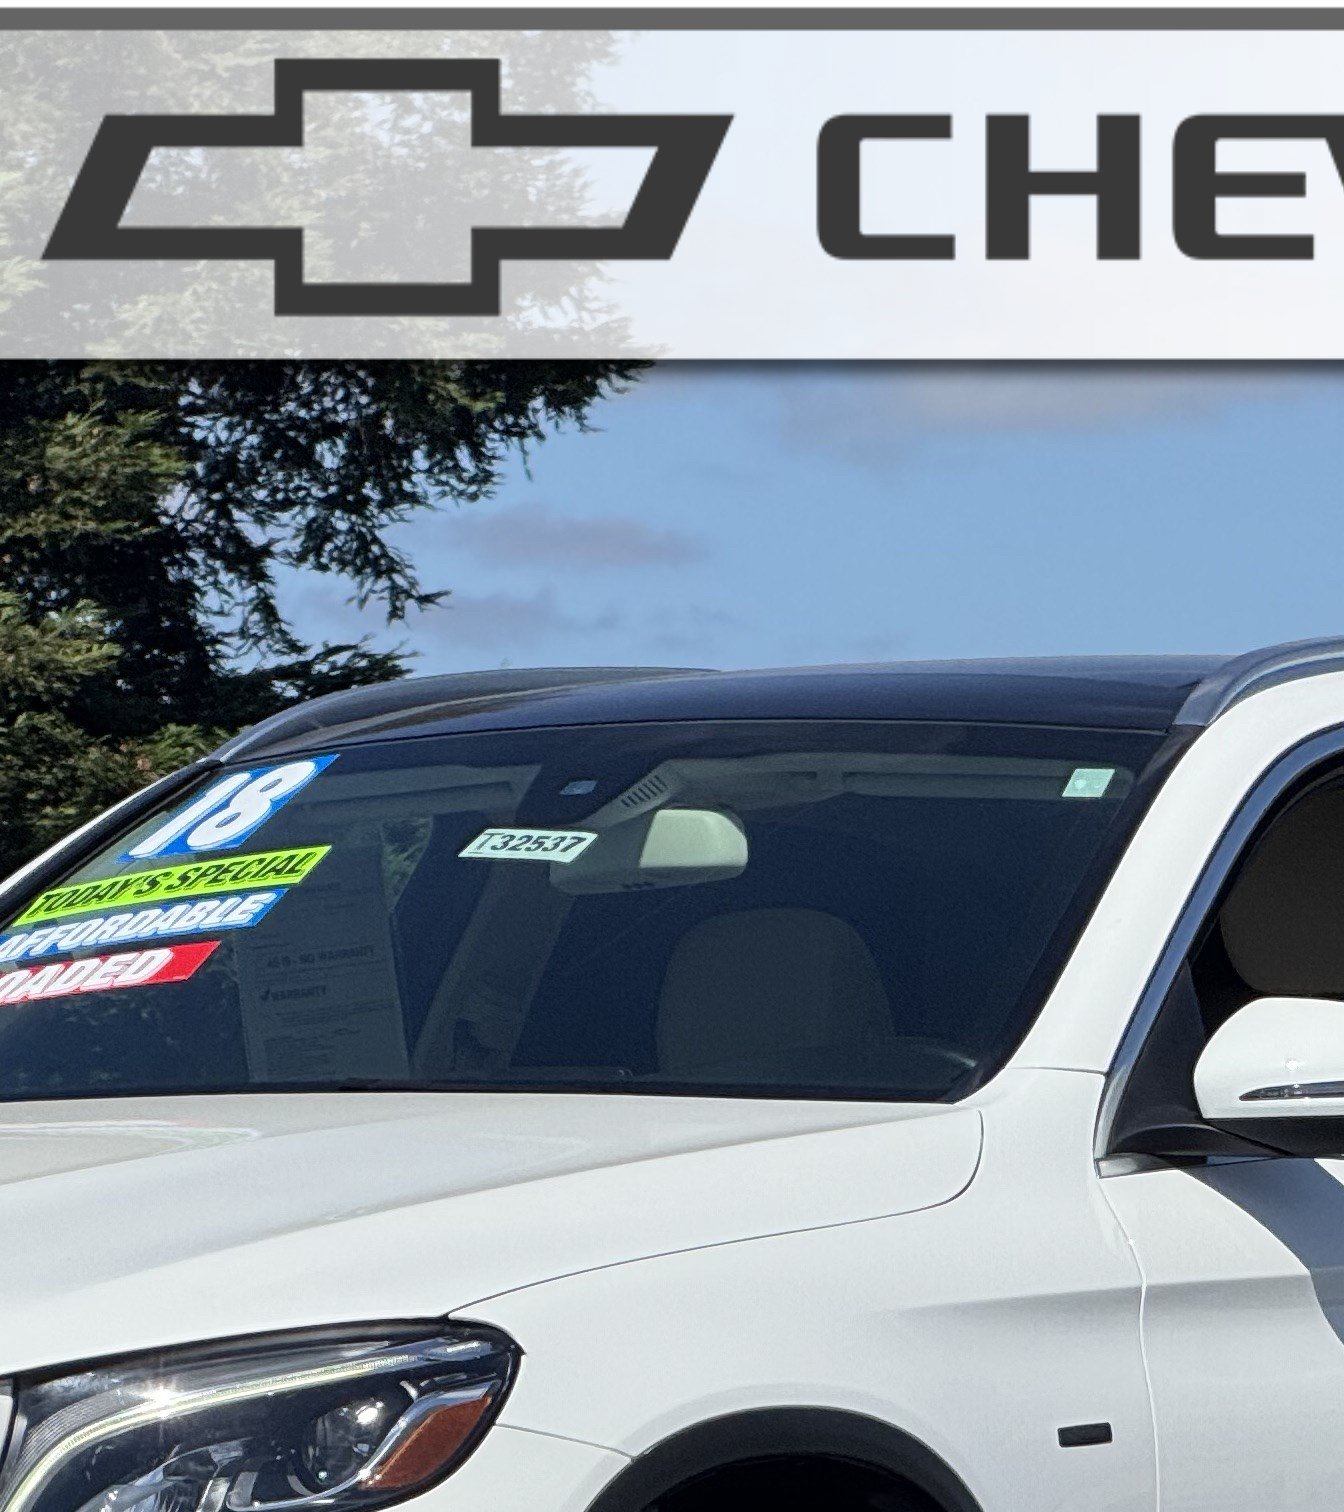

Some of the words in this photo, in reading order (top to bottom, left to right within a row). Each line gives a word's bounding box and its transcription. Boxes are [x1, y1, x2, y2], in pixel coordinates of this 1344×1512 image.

[128, 760, 317, 859] 18
[475, 832, 588, 853] T32537
[29, 870, 174, 918] TODAY'S
[174, 850, 318, 894] SPECIAL
